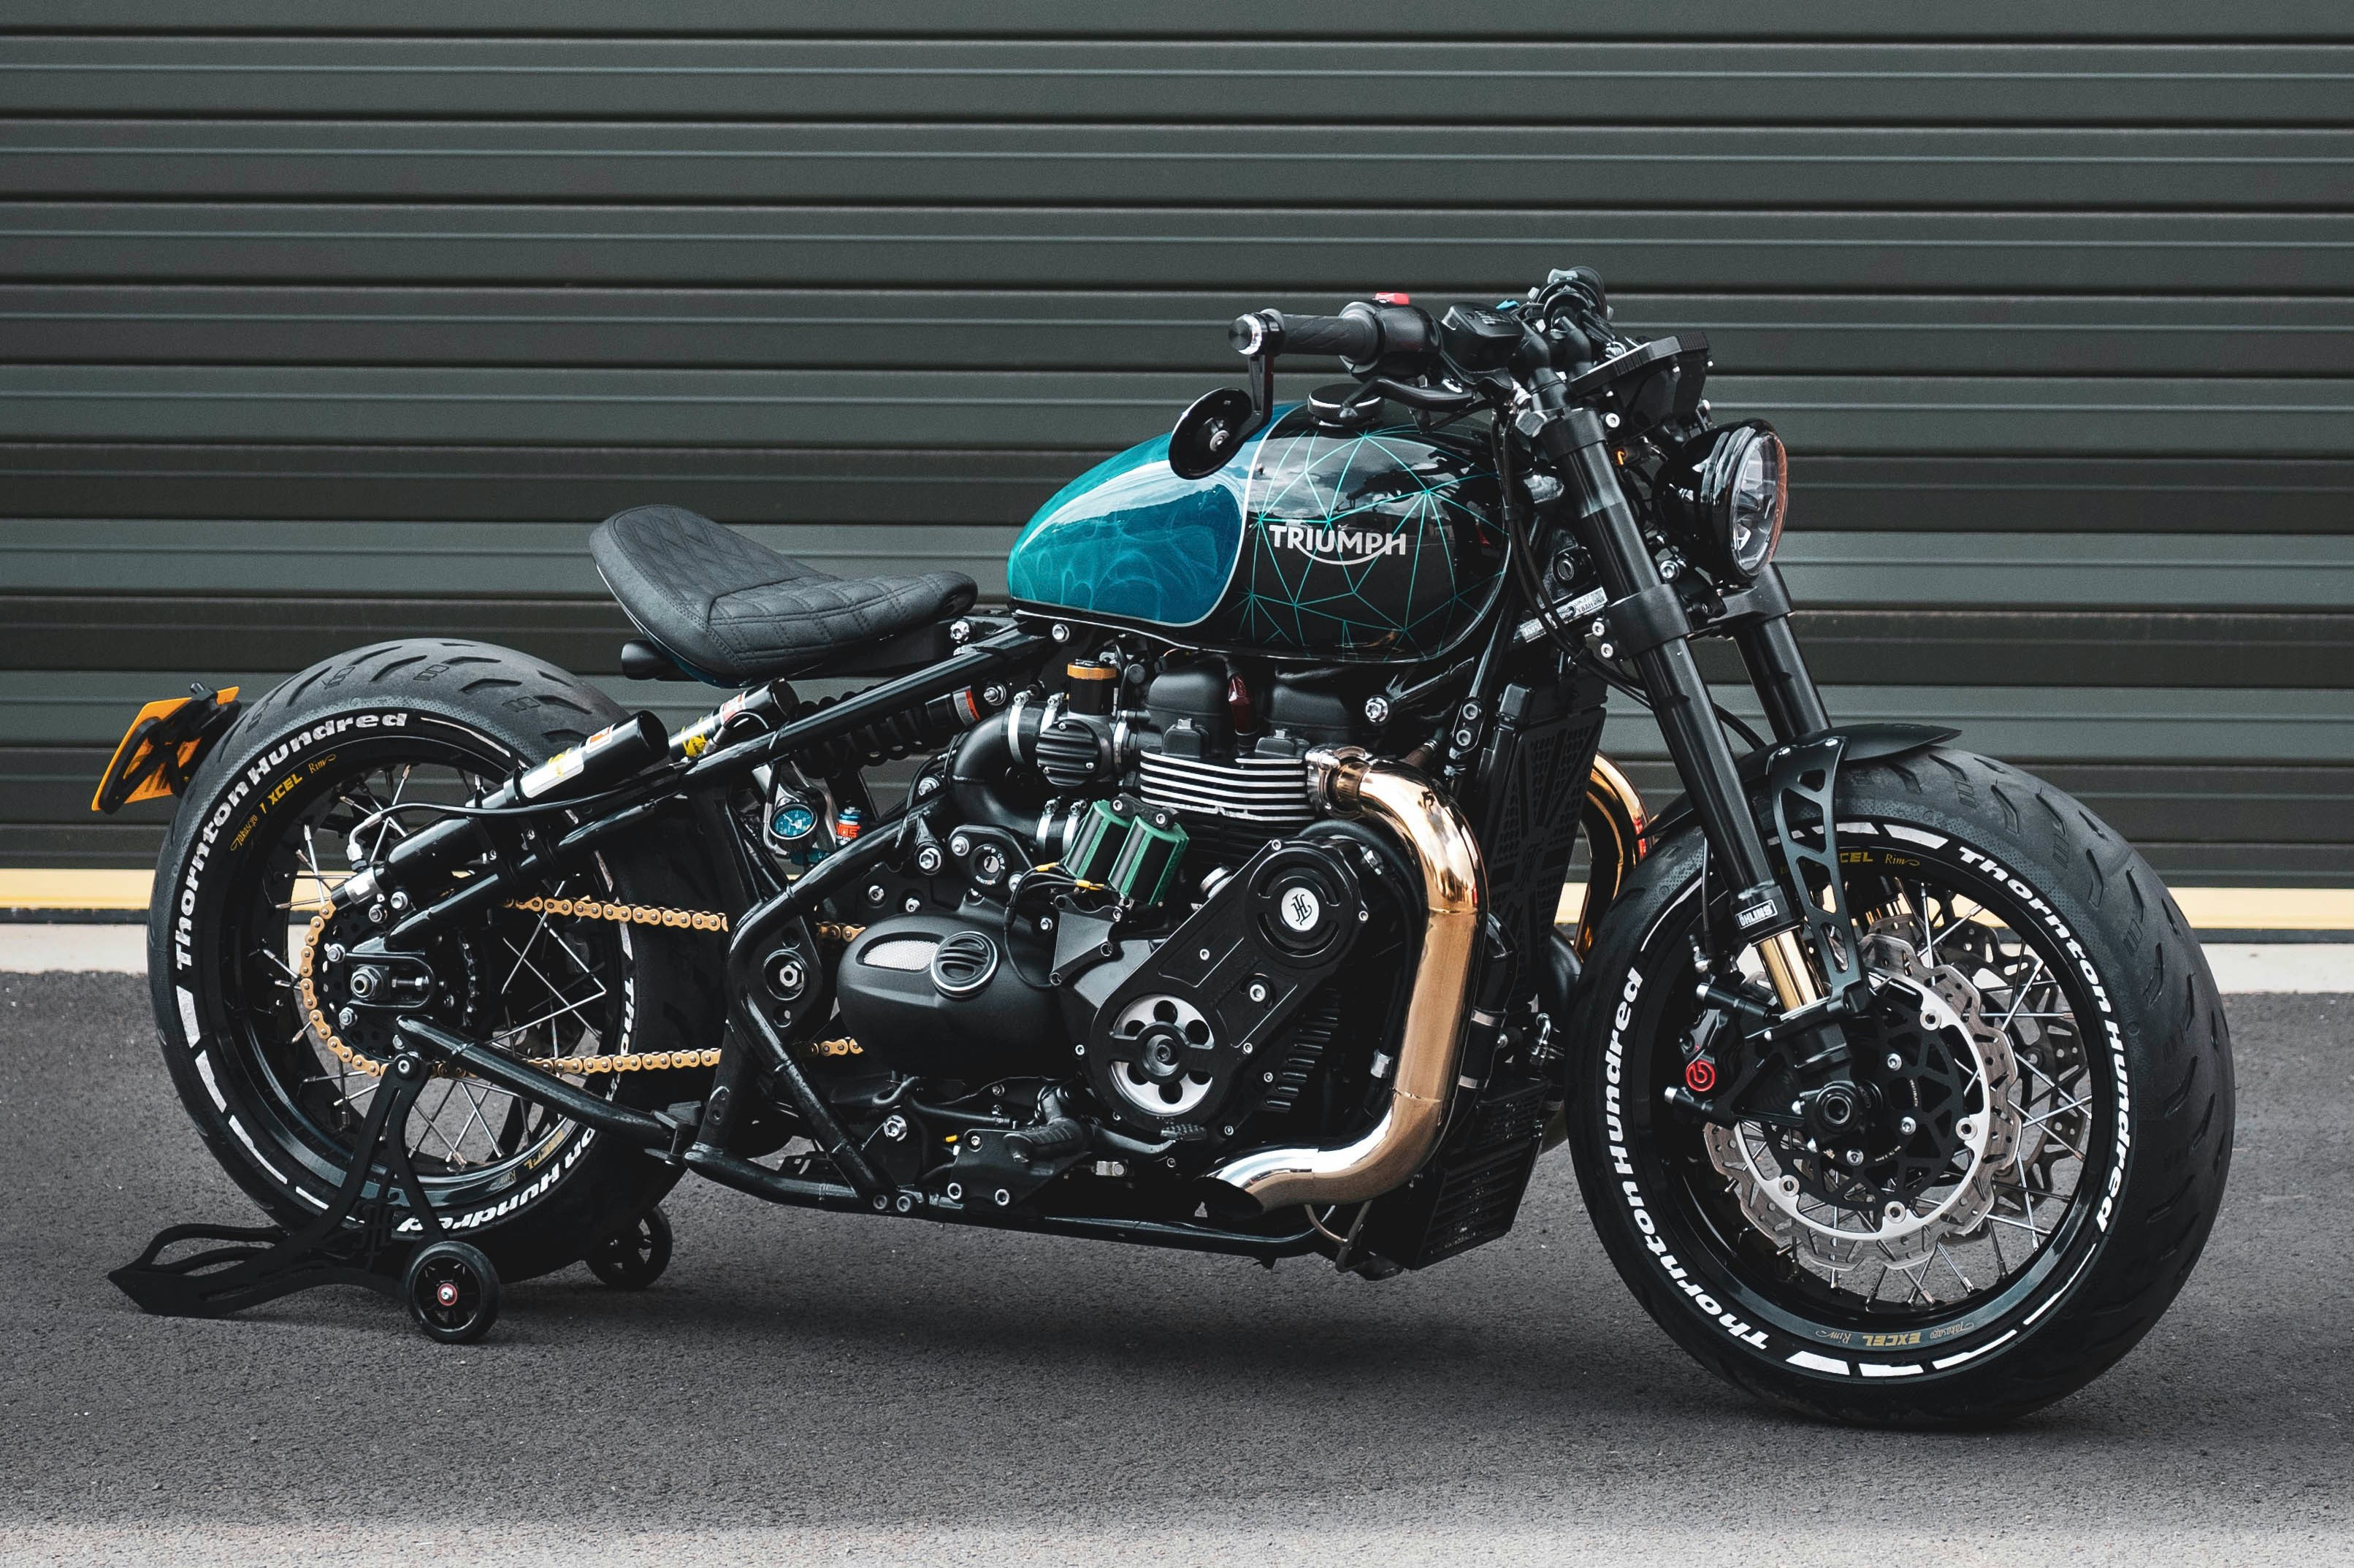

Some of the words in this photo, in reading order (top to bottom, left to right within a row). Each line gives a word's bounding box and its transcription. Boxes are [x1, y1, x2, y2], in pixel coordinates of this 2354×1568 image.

[1269, 524, 1407, 566] TRIUMPH
[175, 781, 250, 971] Thornton
[247, 712, 408, 787] Hundred
[1605, 967, 1643, 1174] Hundred
[1958, 846, 2112, 1013] Thornton
[2095, 1020, 2131, 1233] Hundred
[1622, 1181, 1769, 1350] Thornton
[1862, 1331, 1922, 1347] EXCEL
[1929, 1321, 1975, 1339] Takasago
